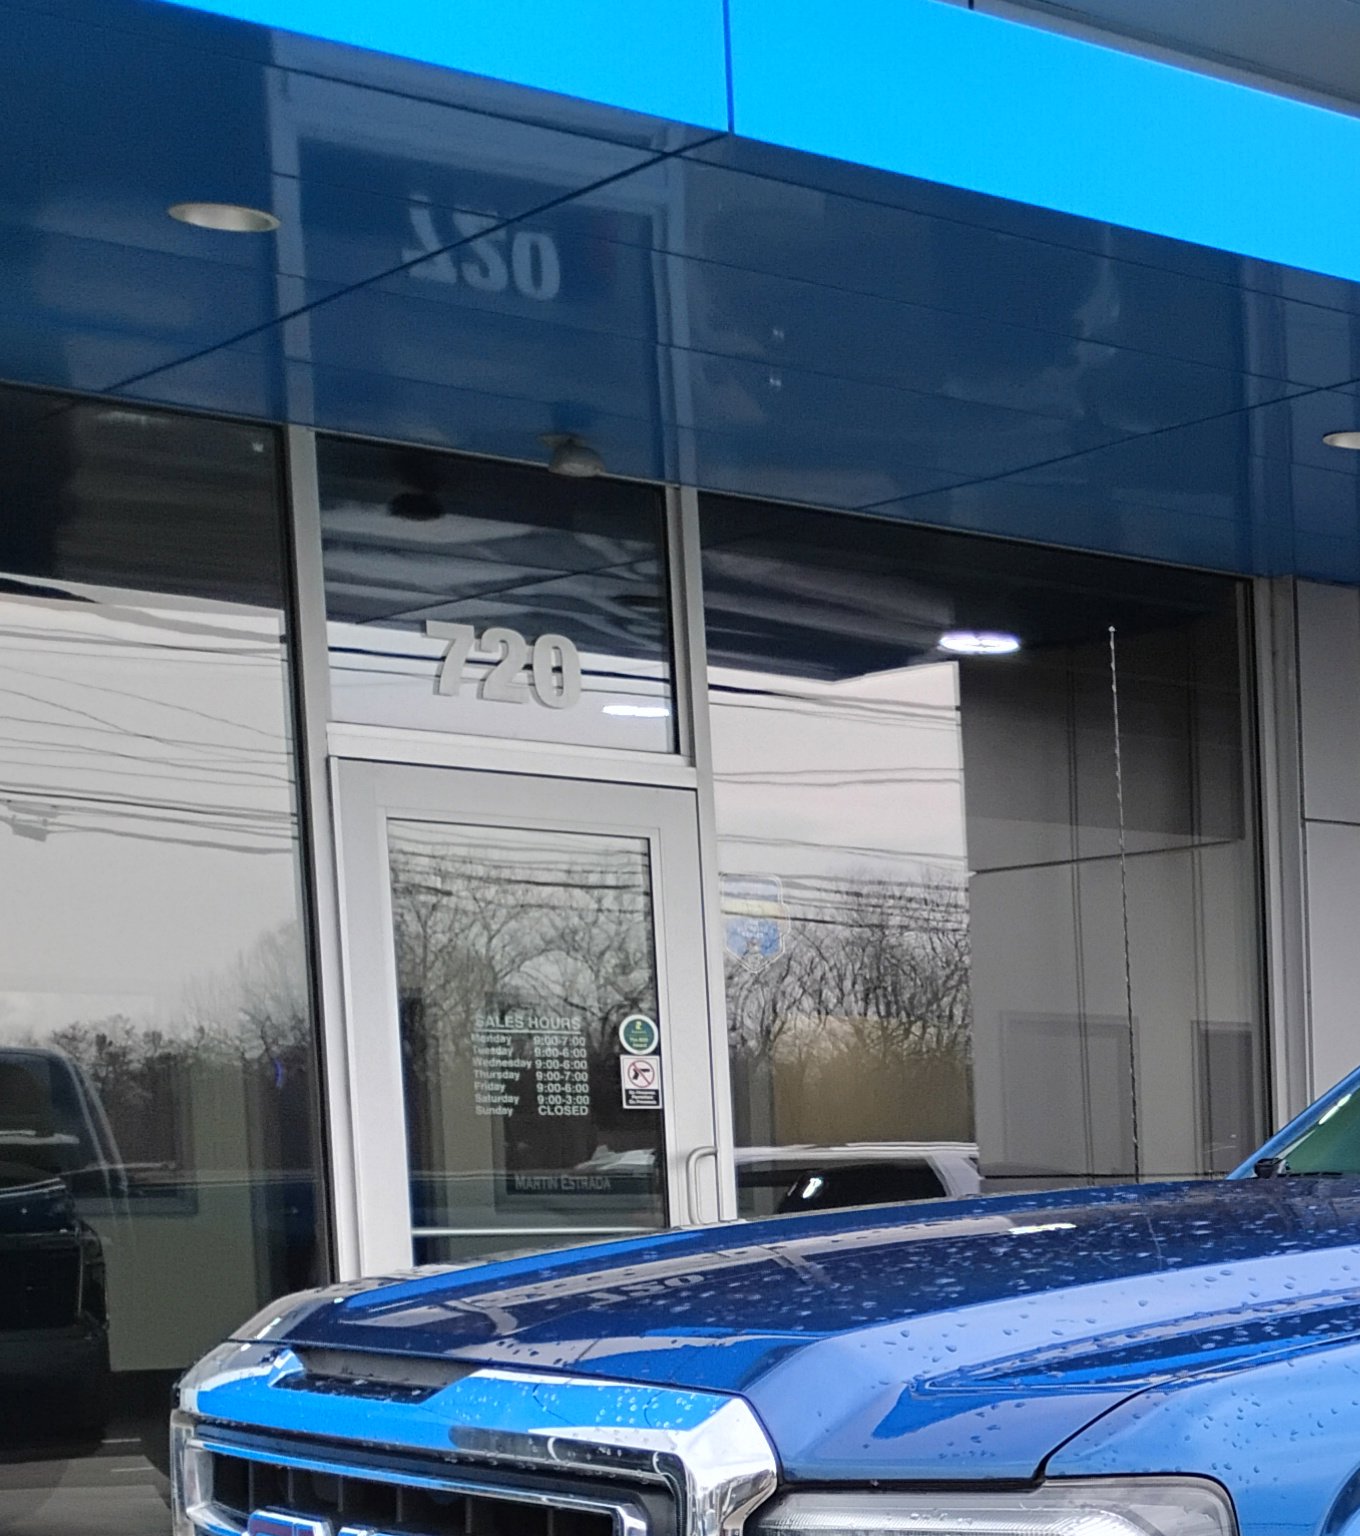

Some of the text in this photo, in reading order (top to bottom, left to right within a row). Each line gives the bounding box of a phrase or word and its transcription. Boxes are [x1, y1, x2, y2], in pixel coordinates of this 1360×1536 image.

[424, 619, 582, 710] 720
[474, 1015, 581, 1030] SALES HOURS
[535, 1059, 588, 1070] 9:00-6:00
[474, 1069, 588, 1082] Thursday 9:00-7:00
[474, 1081, 589, 1093] Friday 9:00-6:00
[475, 1093, 590, 1105] Saturday 9:00-3:00
[475, 1105, 589, 1117] Sunday CLOSED
